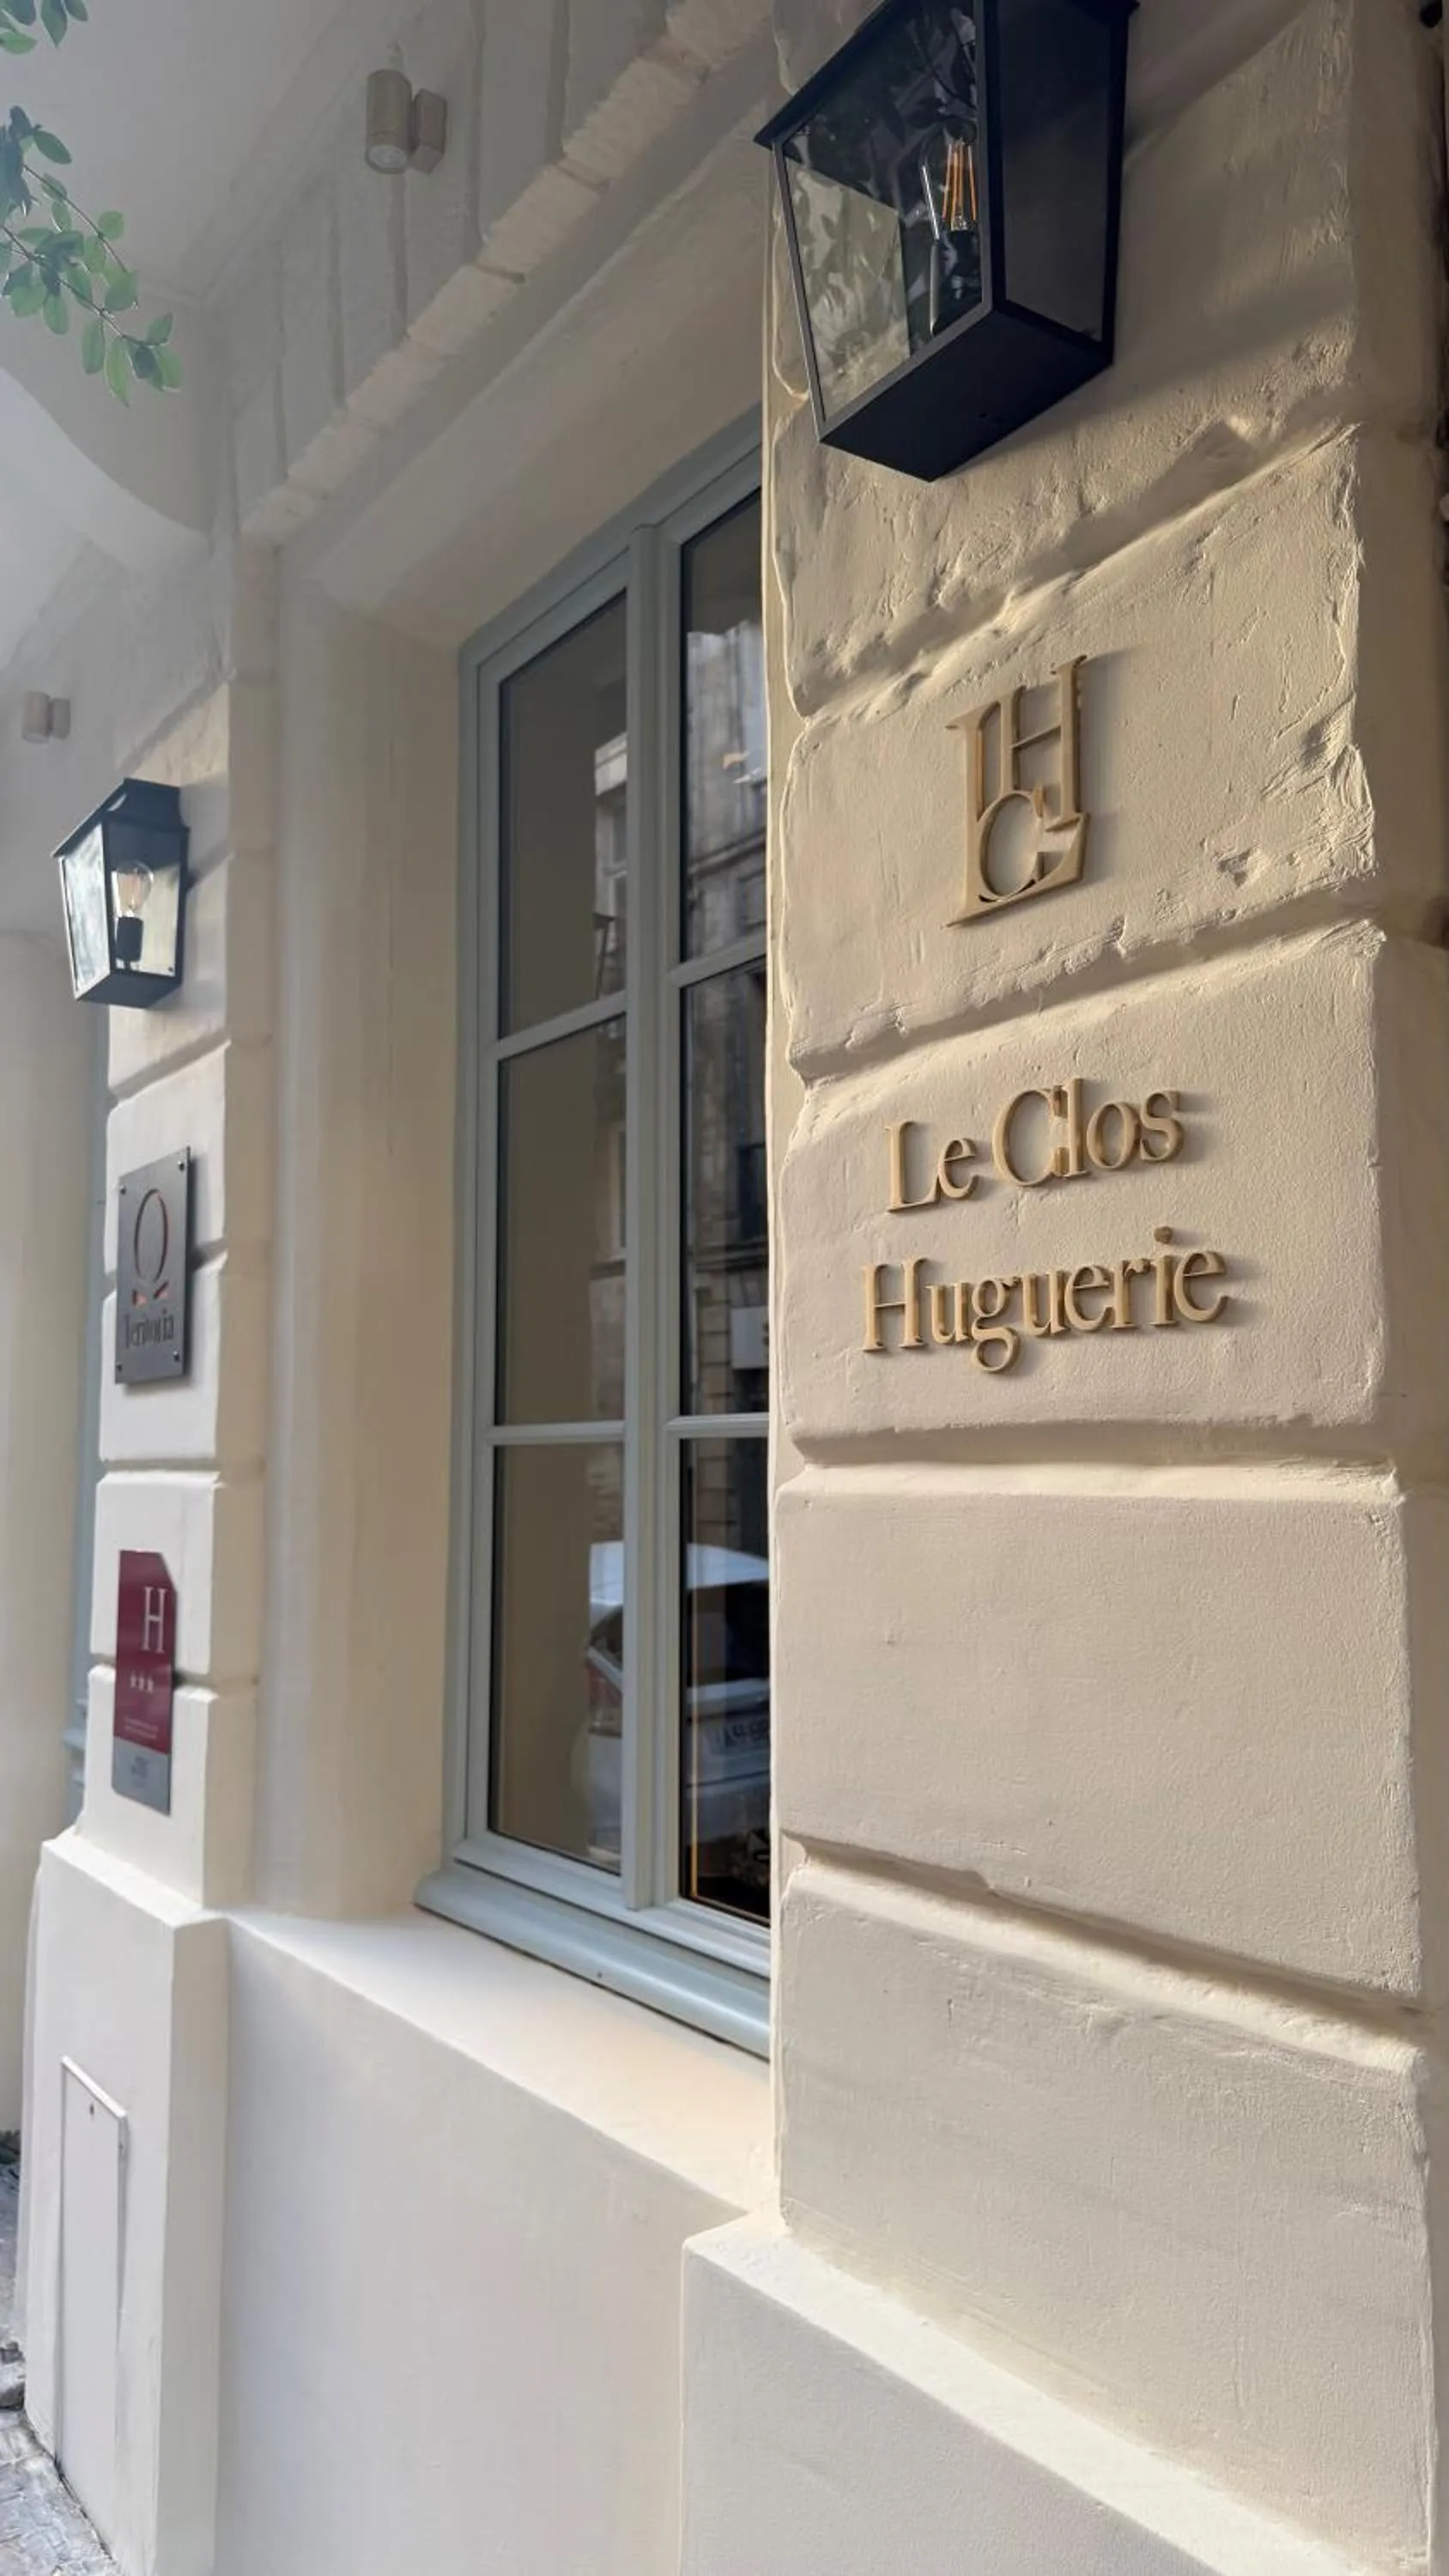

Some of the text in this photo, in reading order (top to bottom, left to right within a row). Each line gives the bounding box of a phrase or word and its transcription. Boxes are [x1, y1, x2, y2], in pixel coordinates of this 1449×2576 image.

[884, 1077, 1185, 1213] Le Clos
[861, 1225, 1230, 1374] Huguerie
[142, 1585, 167, 1655] H
